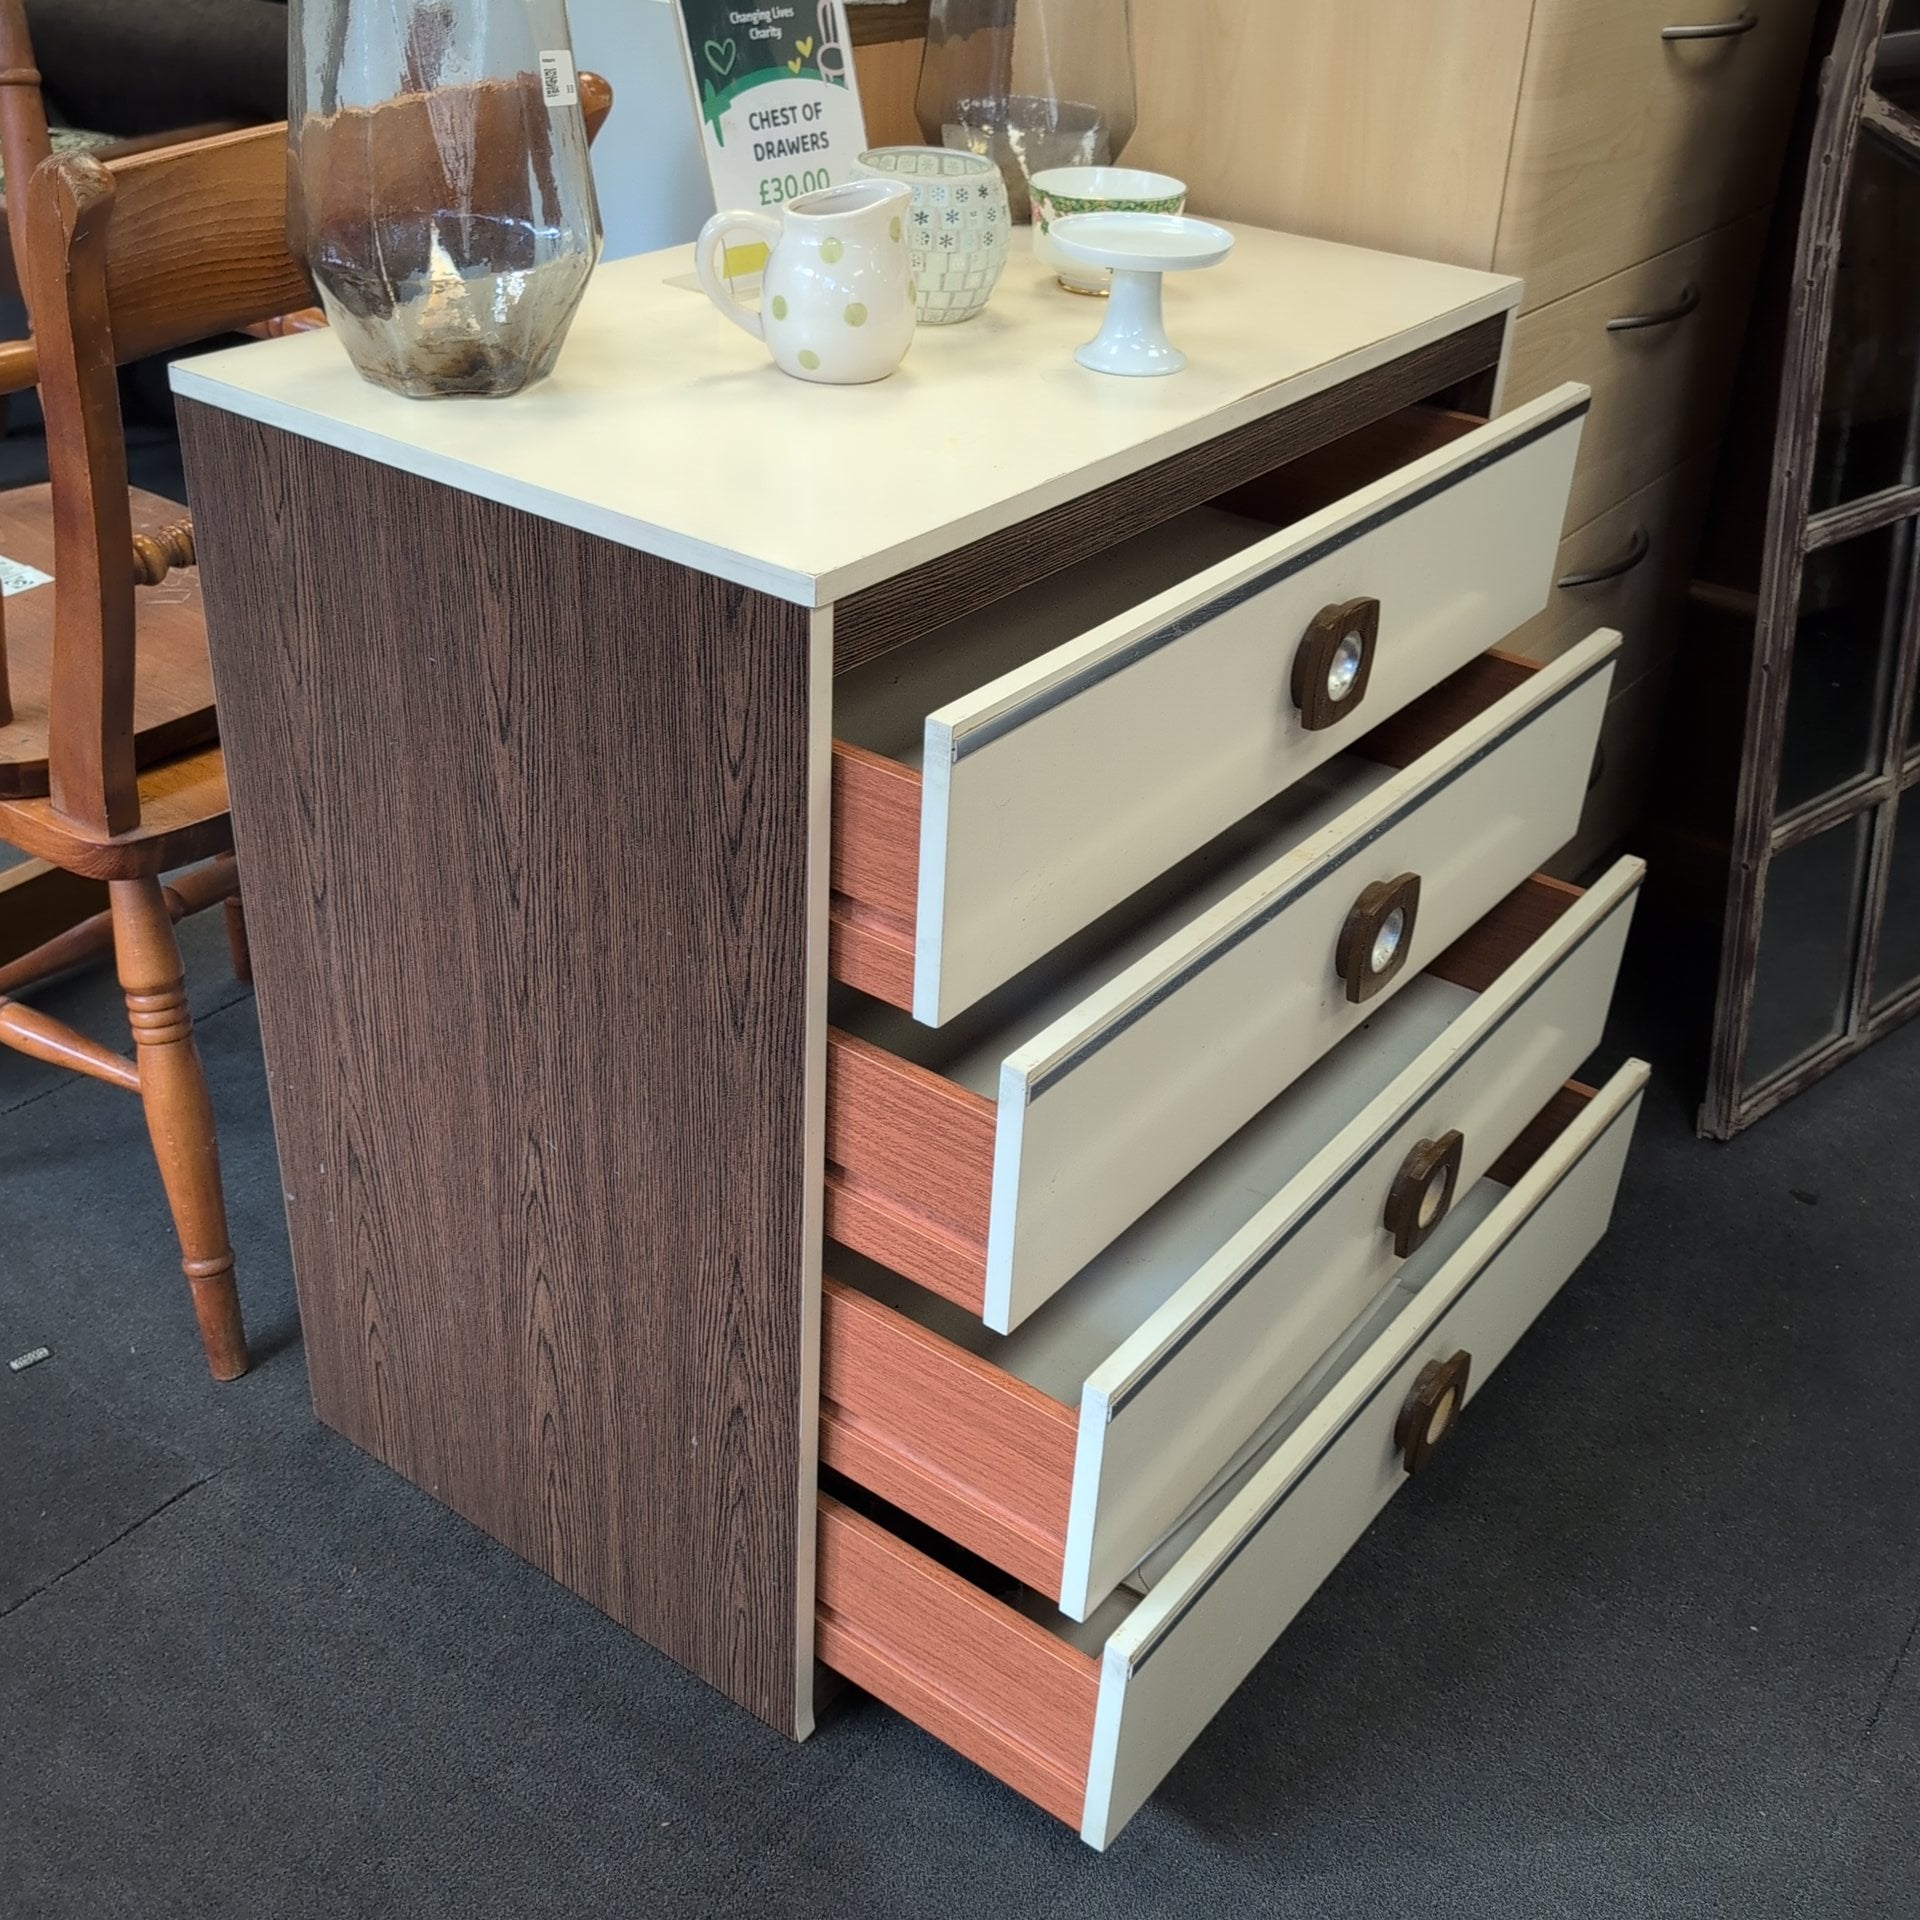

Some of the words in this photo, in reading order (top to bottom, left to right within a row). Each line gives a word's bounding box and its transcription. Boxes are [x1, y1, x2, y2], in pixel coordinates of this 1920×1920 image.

[729, 9, 772, 24] Changing
[771, 6, 795, 19] Lives
[749, 26, 782, 40] Charity
[749, 106, 798, 131] CHEST
[802, 102, 823, 122] OF
[753, 131, 830, 162] DRAWERS
[759, 168, 830, 206] £30.00
